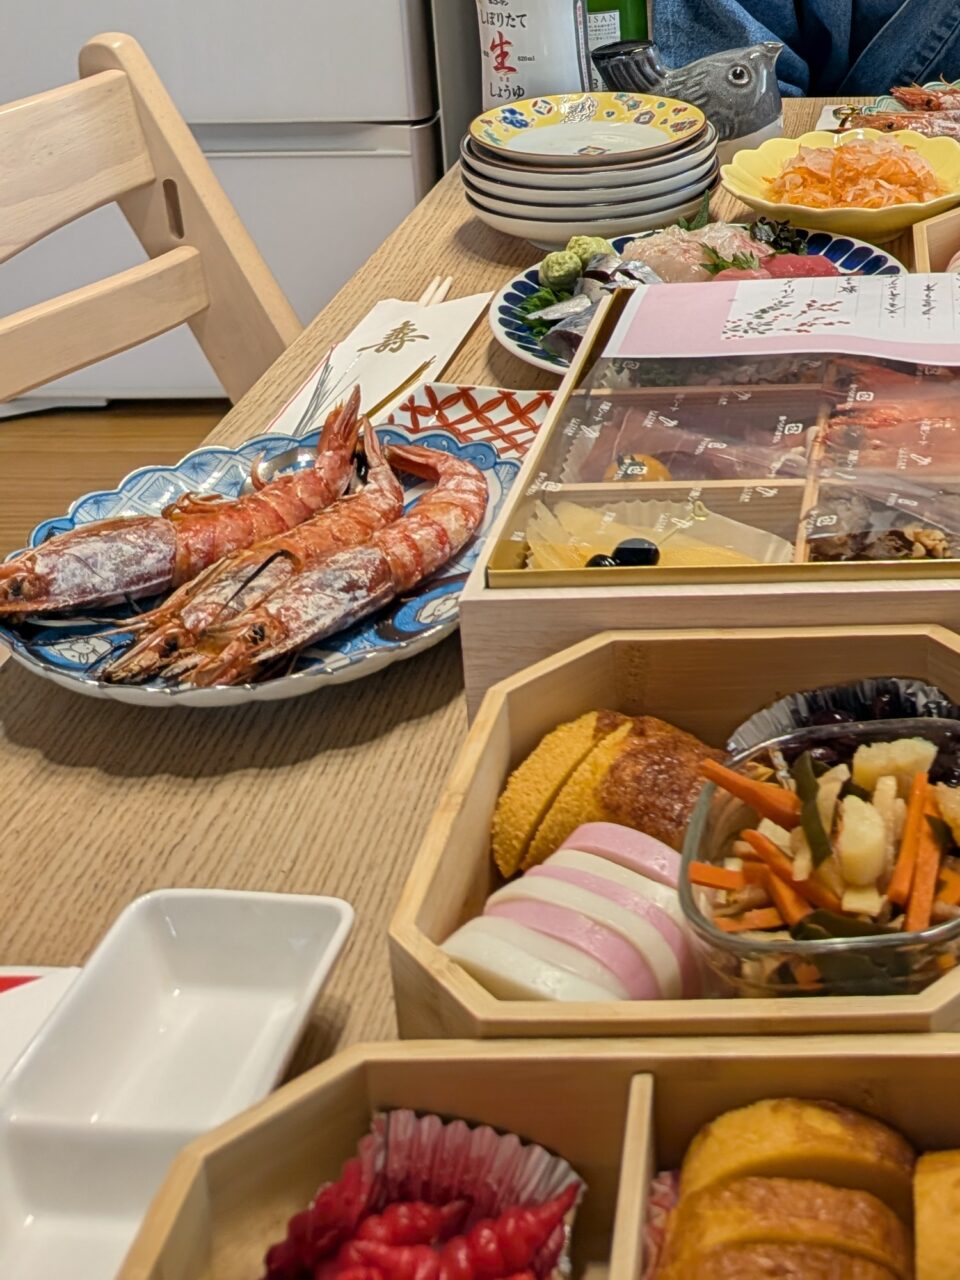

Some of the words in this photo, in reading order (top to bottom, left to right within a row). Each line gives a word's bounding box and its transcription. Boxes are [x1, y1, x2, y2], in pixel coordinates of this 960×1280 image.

[480, 11, 527, 28] しぼりたて
[490, 30, 518, 73] 生
[490, 82, 525, 100] しょうゆ
